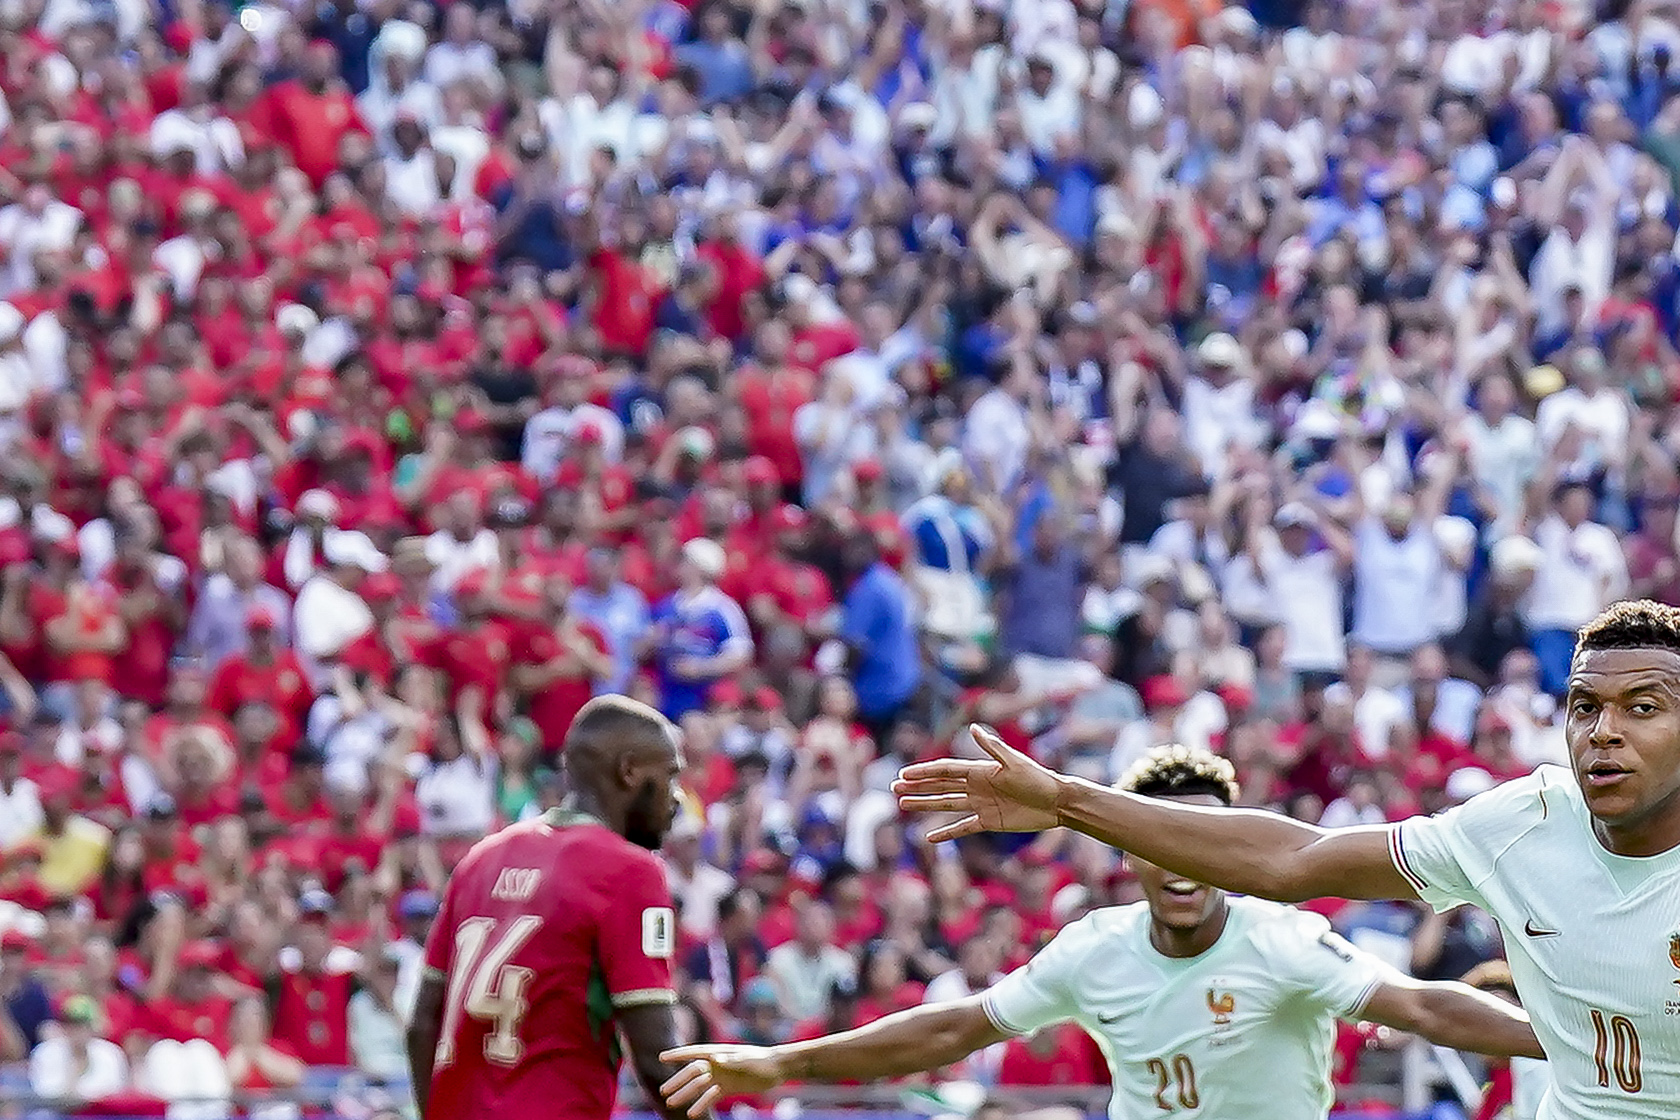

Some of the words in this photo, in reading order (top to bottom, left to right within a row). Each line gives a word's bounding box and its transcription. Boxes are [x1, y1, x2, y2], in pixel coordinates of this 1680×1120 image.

[434, 914, 544, 1067] 14
[1146, 1054, 1200, 1111] 20
[1590, 1009, 1643, 1094] 10
